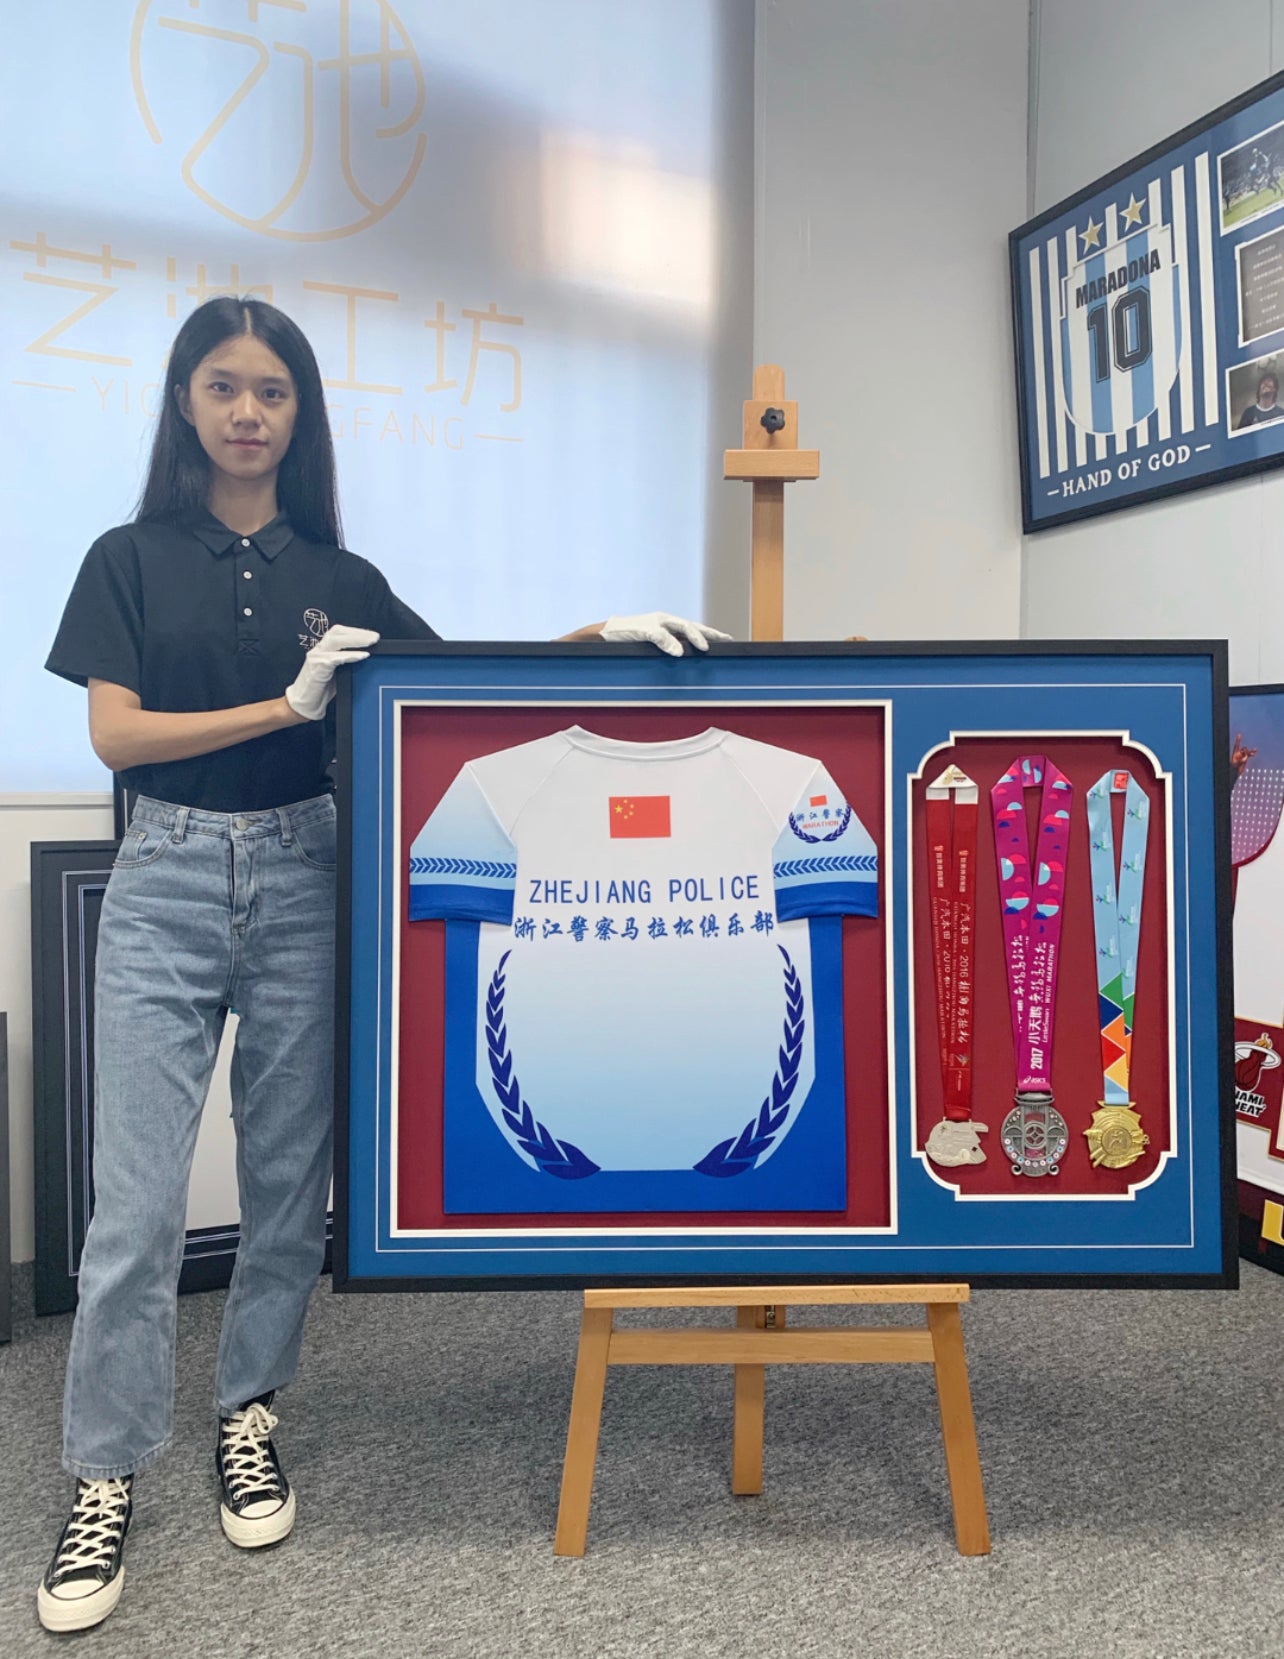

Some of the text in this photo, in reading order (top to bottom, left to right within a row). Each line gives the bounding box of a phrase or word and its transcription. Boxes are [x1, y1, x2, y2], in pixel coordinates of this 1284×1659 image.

[1075, 249, 1161, 308] MARADONA
[1086, 285, 1153, 383] 10
[1062, 444, 1191, 497] HAND OF GOD
[802, 820, 839, 830] MARATHON
[529, 875, 759, 904] ZHEJIANG POLICE
[514, 909, 775, 942] 浙江警察马拉松俱乐部
[1046, 943, 1055, 982] MARATHON
[1031, 1047, 1044, 1070] 2017
